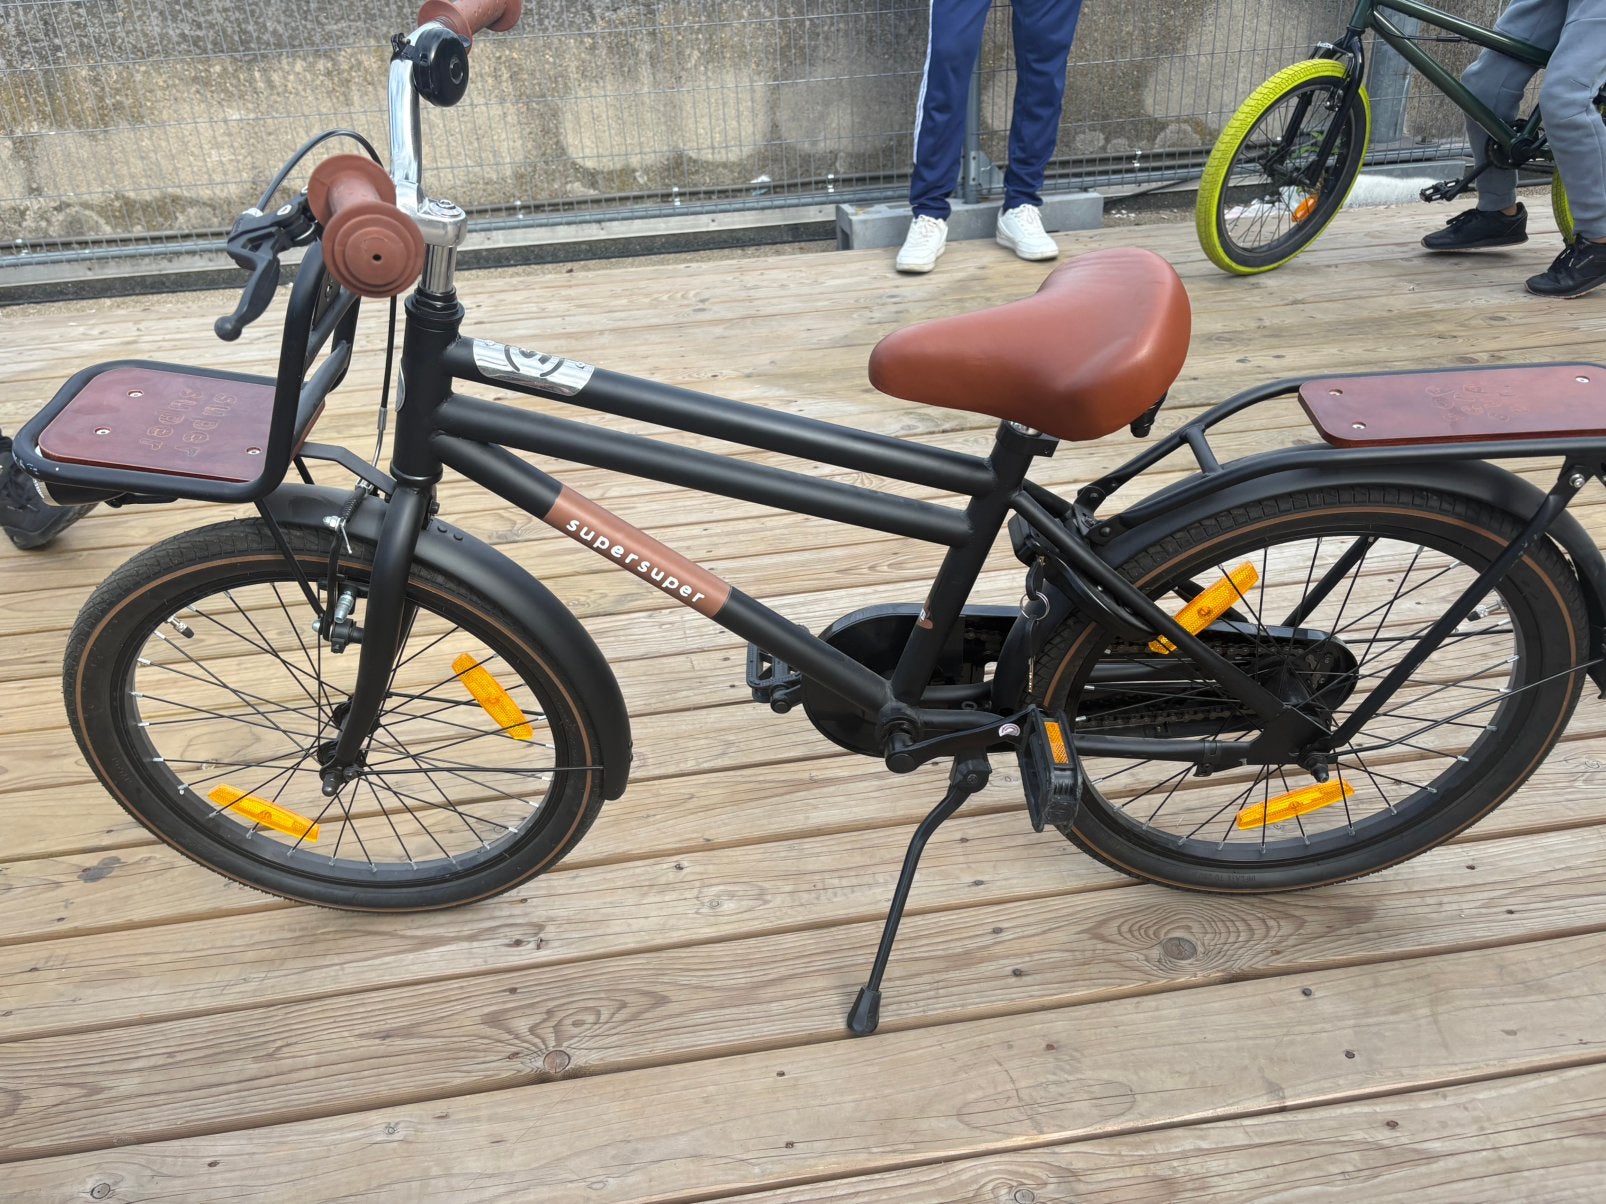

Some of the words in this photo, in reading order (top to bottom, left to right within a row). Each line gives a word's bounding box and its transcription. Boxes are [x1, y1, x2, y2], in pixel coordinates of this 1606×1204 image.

[139, 388, 203, 451] super
[174, 393, 238, 457] super
[565, 518, 705, 604] supersuper
